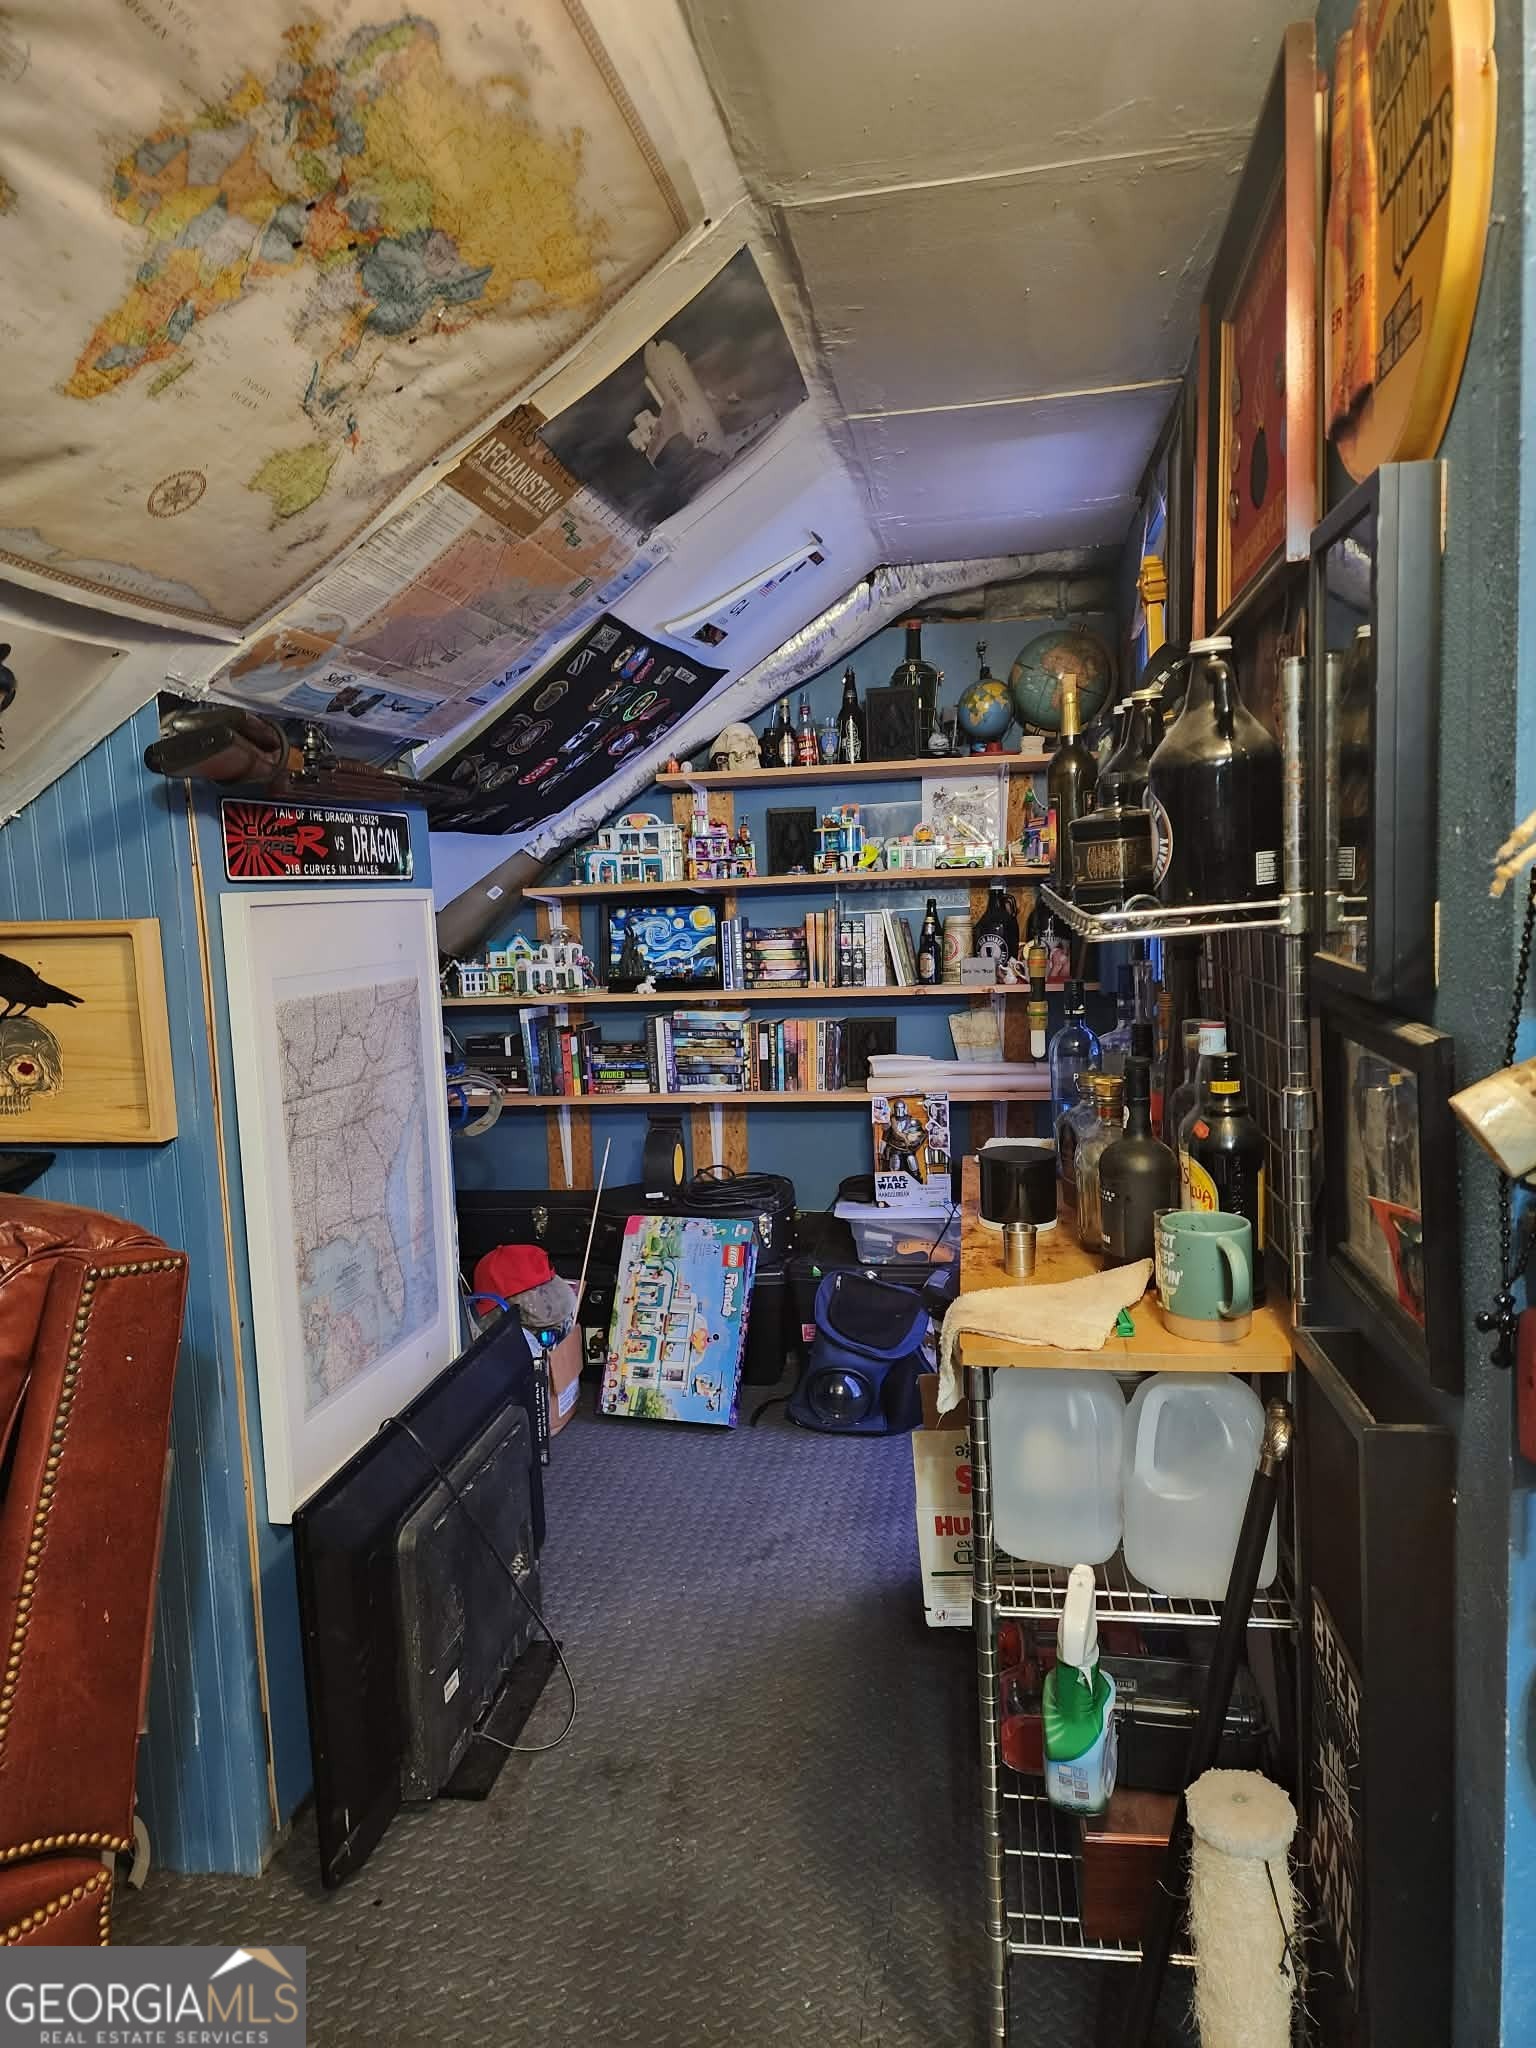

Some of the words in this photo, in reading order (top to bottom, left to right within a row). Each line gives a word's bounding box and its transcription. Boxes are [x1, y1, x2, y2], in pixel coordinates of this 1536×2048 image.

[474, 437, 565, 513] AFGHANISTAN
[274, 807, 294, 820] TAIL
[295, 808, 305, 820] OF
[309, 809, 324, 822] THE
[325, 812, 354, 824] DRAGON
[360, 814, 379, 825] US129
[242, 823, 293, 838] CIVIC
[244, 839, 295, 855] TYPE
[296, 826, 329, 858] R
[334, 836, 345, 851] VS
[351, 826, 401, 863] DRAGON
[285, 863, 300, 875] 318
[303, 864, 337, 875] CURVES
[339, 865, 347, 875] IN
[349, 865, 356, 875] 11
[358, 865, 379, 875] MILES
[878, 1175, 908, 1183] STAR
[878, 1182, 908, 1190] WARS
[727, 1246, 739, 1268] LEGO
[721, 1272, 739, 1317] Friends
[1313, 1601, 1359, 1724] BEER
[1312, 1837, 1355, 1992] CAVE
